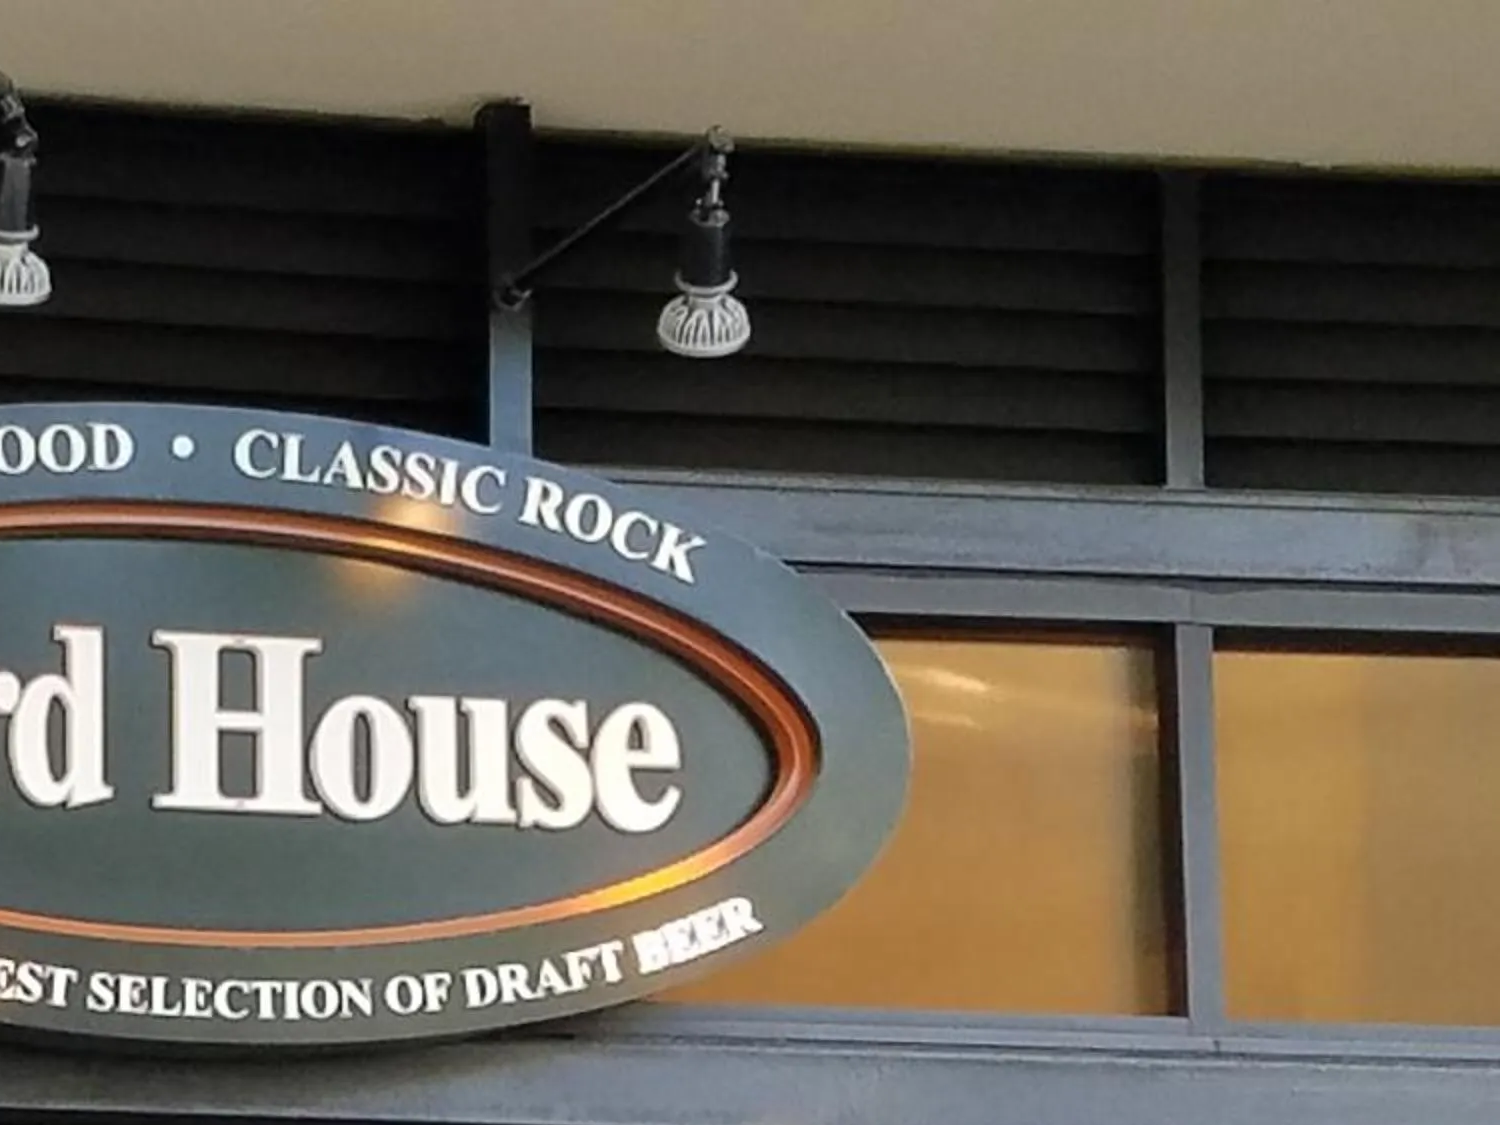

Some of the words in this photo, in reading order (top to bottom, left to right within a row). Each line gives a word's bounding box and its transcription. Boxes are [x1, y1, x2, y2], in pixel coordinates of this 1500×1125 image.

[232, 428, 506, 515] CLASSIC
[517, 475, 707, 585] ROCK
[150, 628, 683, 836] House
[85, 971, 374, 1021] SELECTION
[384, 970, 453, 1016] OF
[453, 940, 625, 1005] DRAFT
[630, 896, 765, 976] BEER
